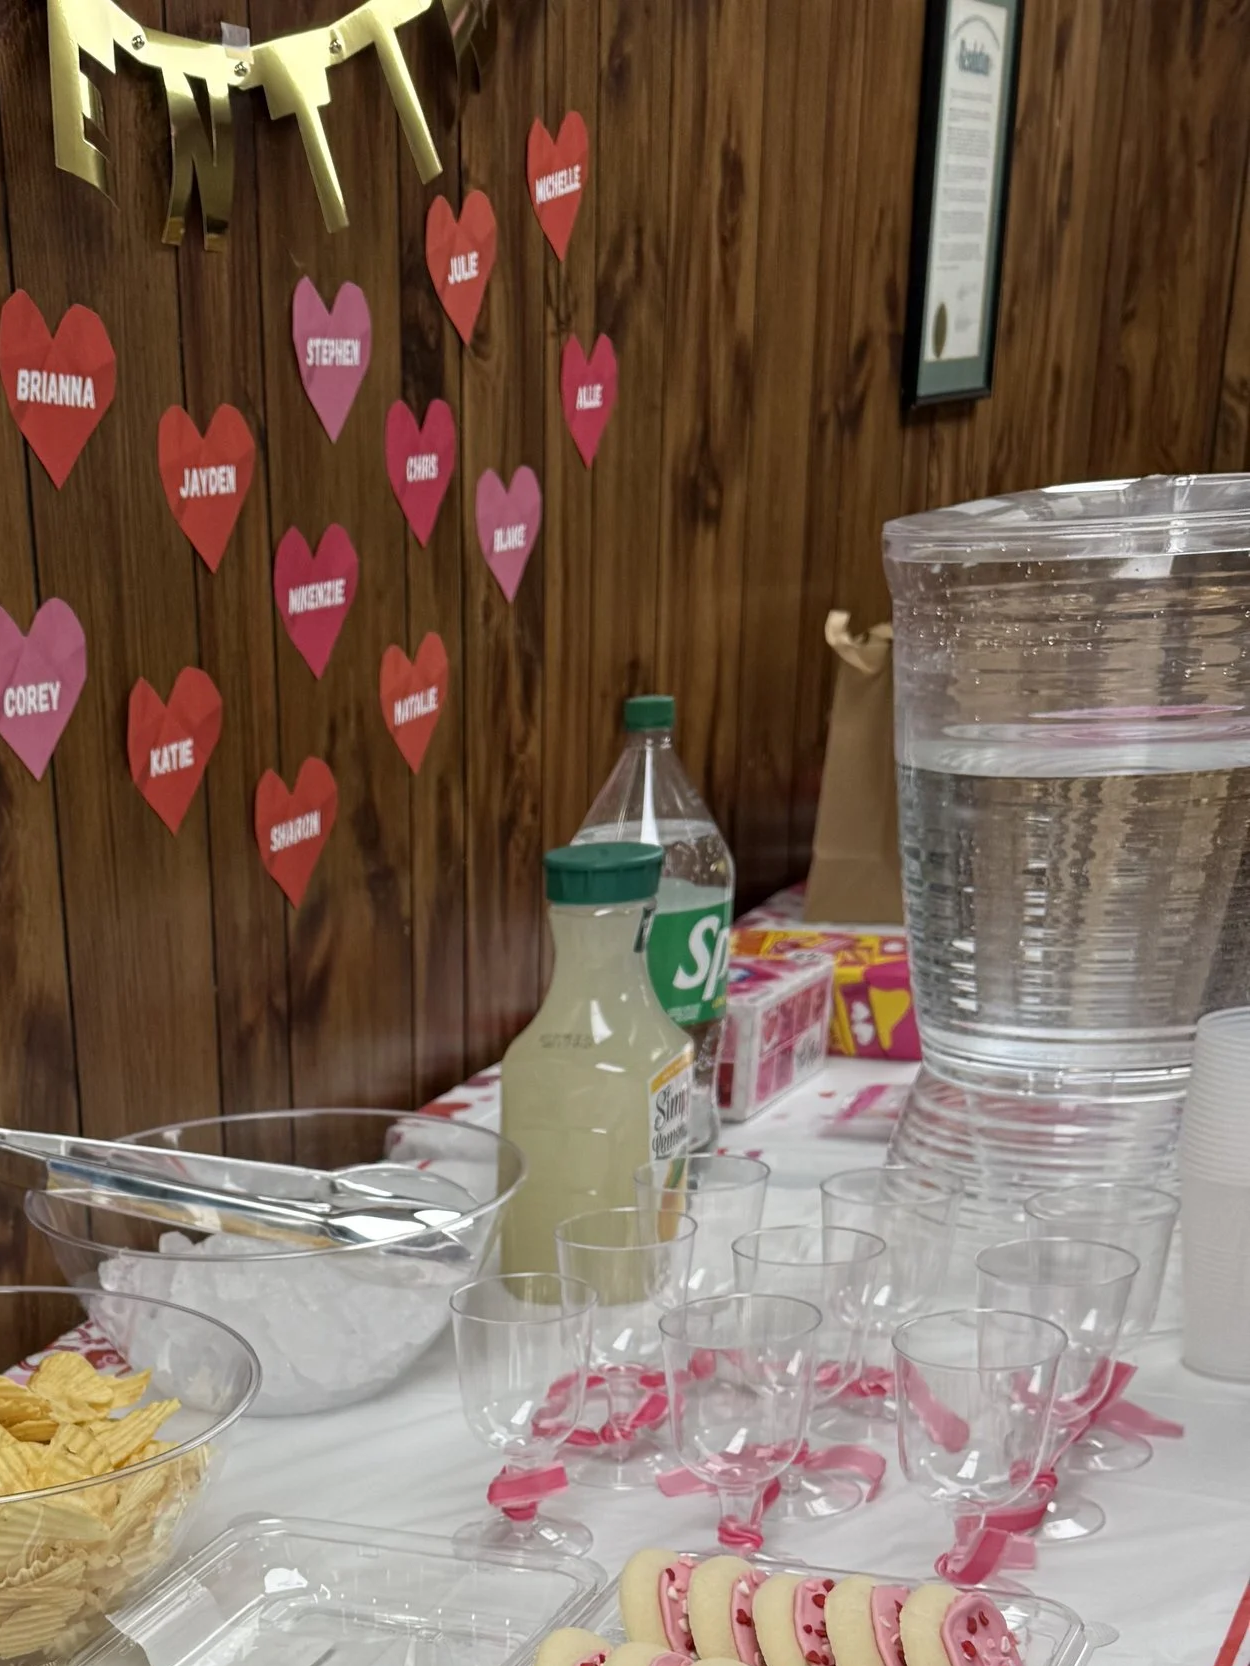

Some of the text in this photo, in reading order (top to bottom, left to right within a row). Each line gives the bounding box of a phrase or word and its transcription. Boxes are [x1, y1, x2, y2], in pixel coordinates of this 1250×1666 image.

[535, 164, 582, 204] MICHELLE
[448, 251, 479, 285] JULIE
[306, 338, 361, 367] STEPHEN
[16, 369, 96, 409] BRIANNA
[576, 384, 603, 411] ALLIE
[179, 465, 236, 499] JAYDEN
[406, 454, 438, 482] CHRIS
[493, 523, 527, 553] BLAKE
[3, 680, 61, 718] COREY
[394, 686, 438, 726] NATALIE
[150, 738, 195, 778] KATIE
[270, 810, 321, 853] SHARON
